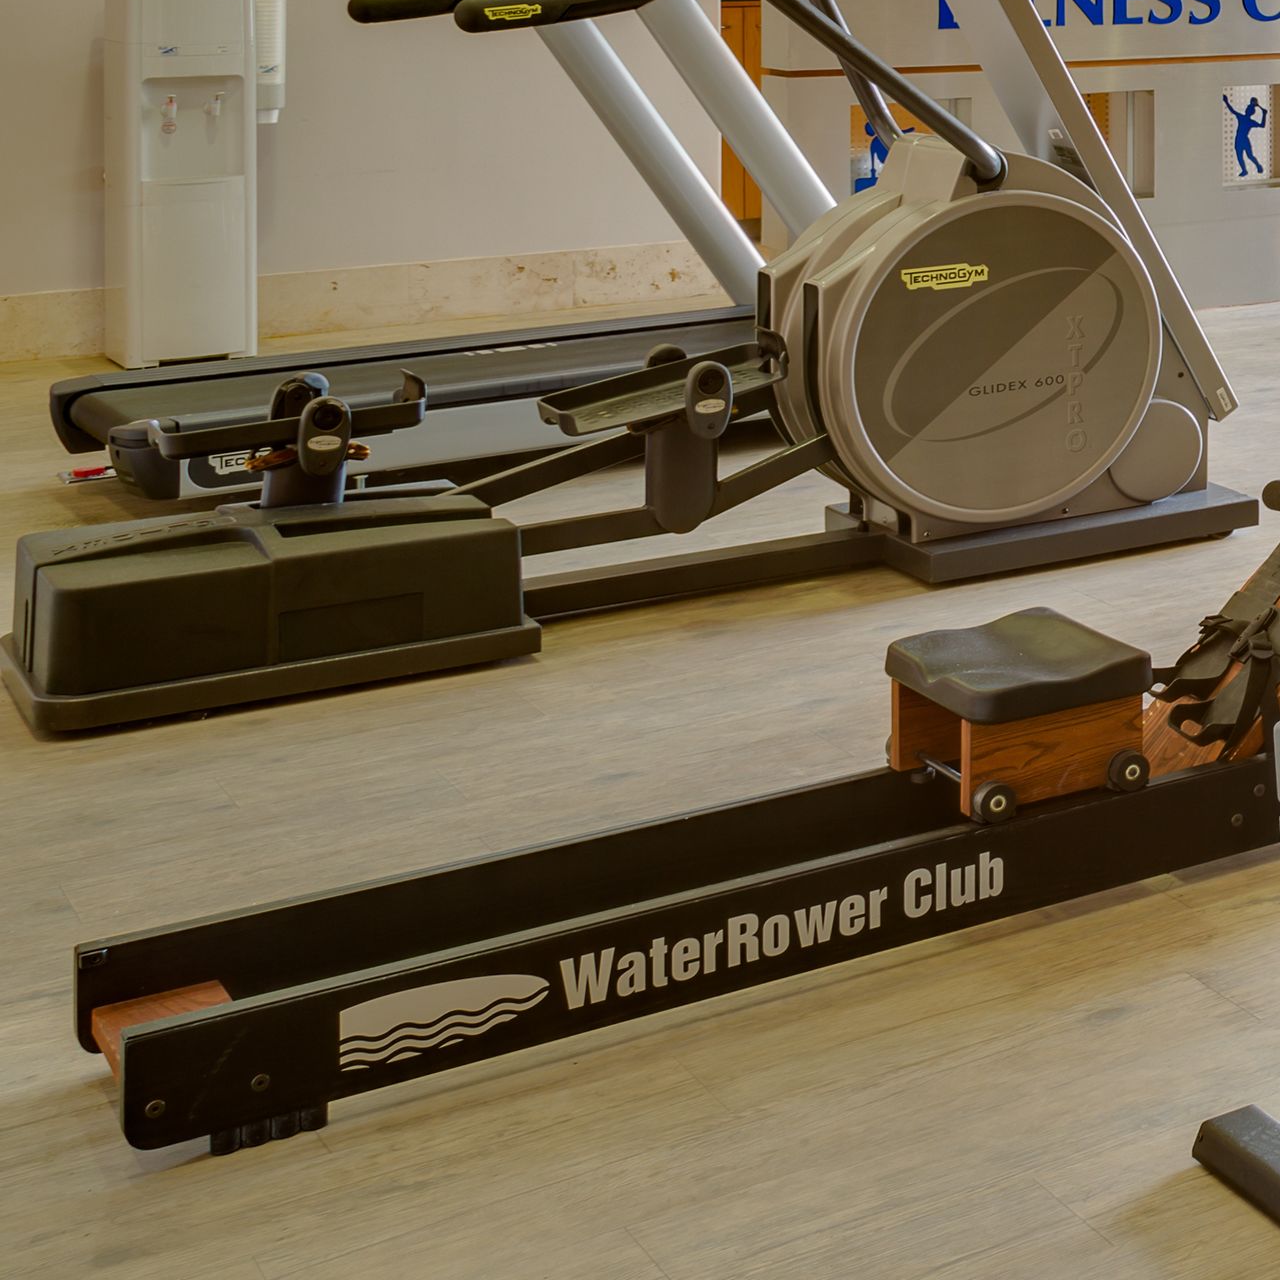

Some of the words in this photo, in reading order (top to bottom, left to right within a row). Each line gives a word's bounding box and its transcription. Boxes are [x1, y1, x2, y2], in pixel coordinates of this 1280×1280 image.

[903, 267, 985, 286] TECHNOGYM
[967, 380, 1028, 397] GLIDEX
[1034, 374, 1065, 389] 600
[559, 885, 888, 1010] WaterRower
[902, 850, 1005, 919] Club
